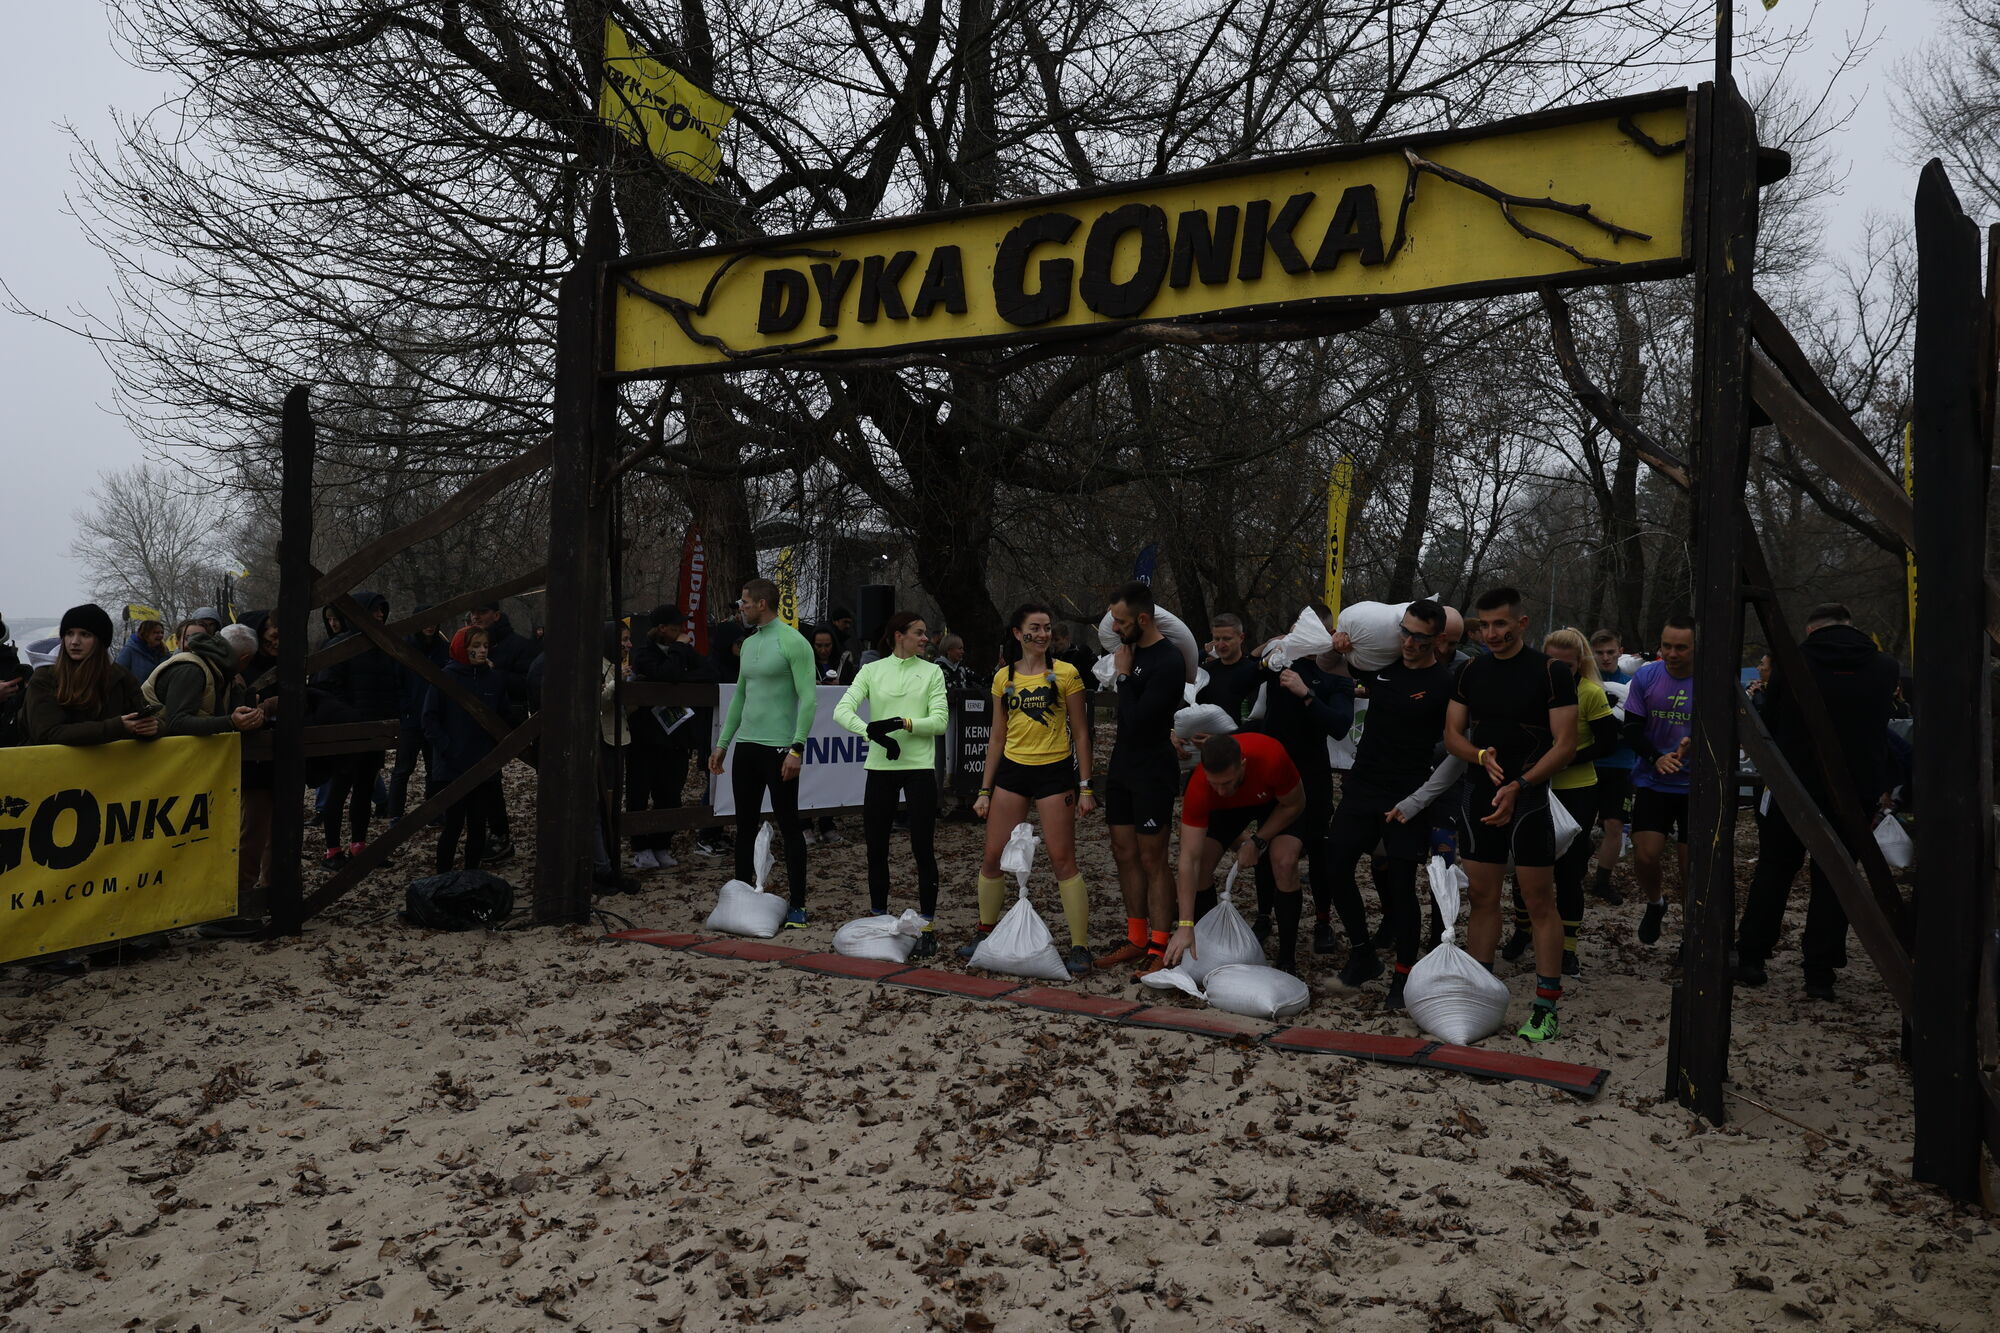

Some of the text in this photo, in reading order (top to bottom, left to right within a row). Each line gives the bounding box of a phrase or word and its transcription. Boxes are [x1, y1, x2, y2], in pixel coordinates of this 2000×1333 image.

[757, 184, 1385, 334] DYKA GONKA
[801, 736, 869, 765] NNE
[11, 870, 164, 911] KA.COM.UA
